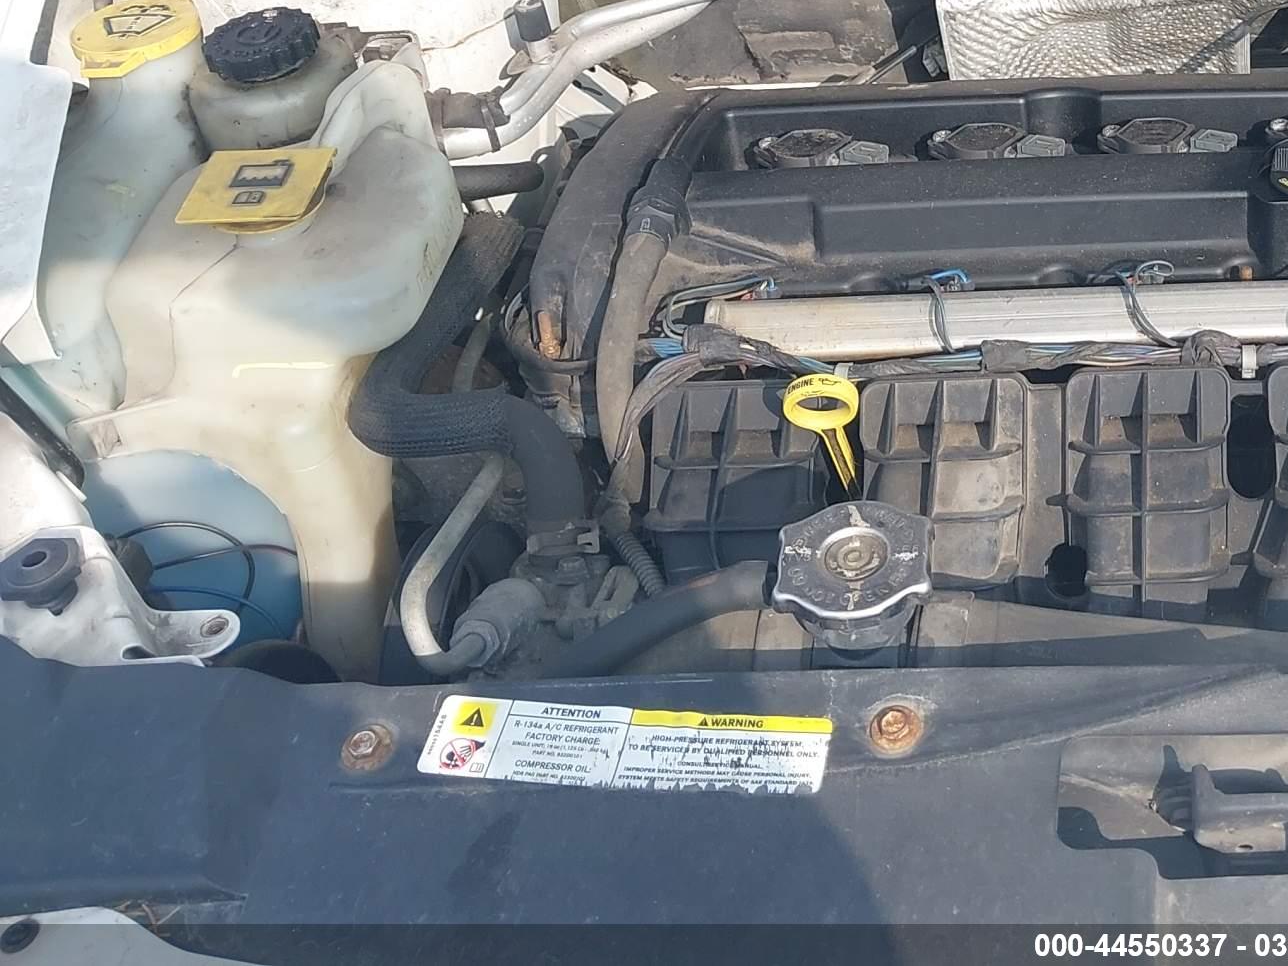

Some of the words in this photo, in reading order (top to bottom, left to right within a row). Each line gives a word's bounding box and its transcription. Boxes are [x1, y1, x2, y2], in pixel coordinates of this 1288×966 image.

[787, 378, 814, 395] ENGINE
[541, 707, 601, 718] ATTENTION
[514, 720, 543, 728] R-134a
[544, 723, 563, 731] A/C
[563, 724, 619, 735] REFRIGERANT
[711, 718, 764, 728] WARNING
[525, 732, 562, 742] FACTORY
[651, 734, 714, 744] HIGH-PRESSURE
[715, 737, 768, 746] REFRIGERANT
[515, 759, 574, 772] COMPRESSOR
[575, 765, 591, 773] OIL:
